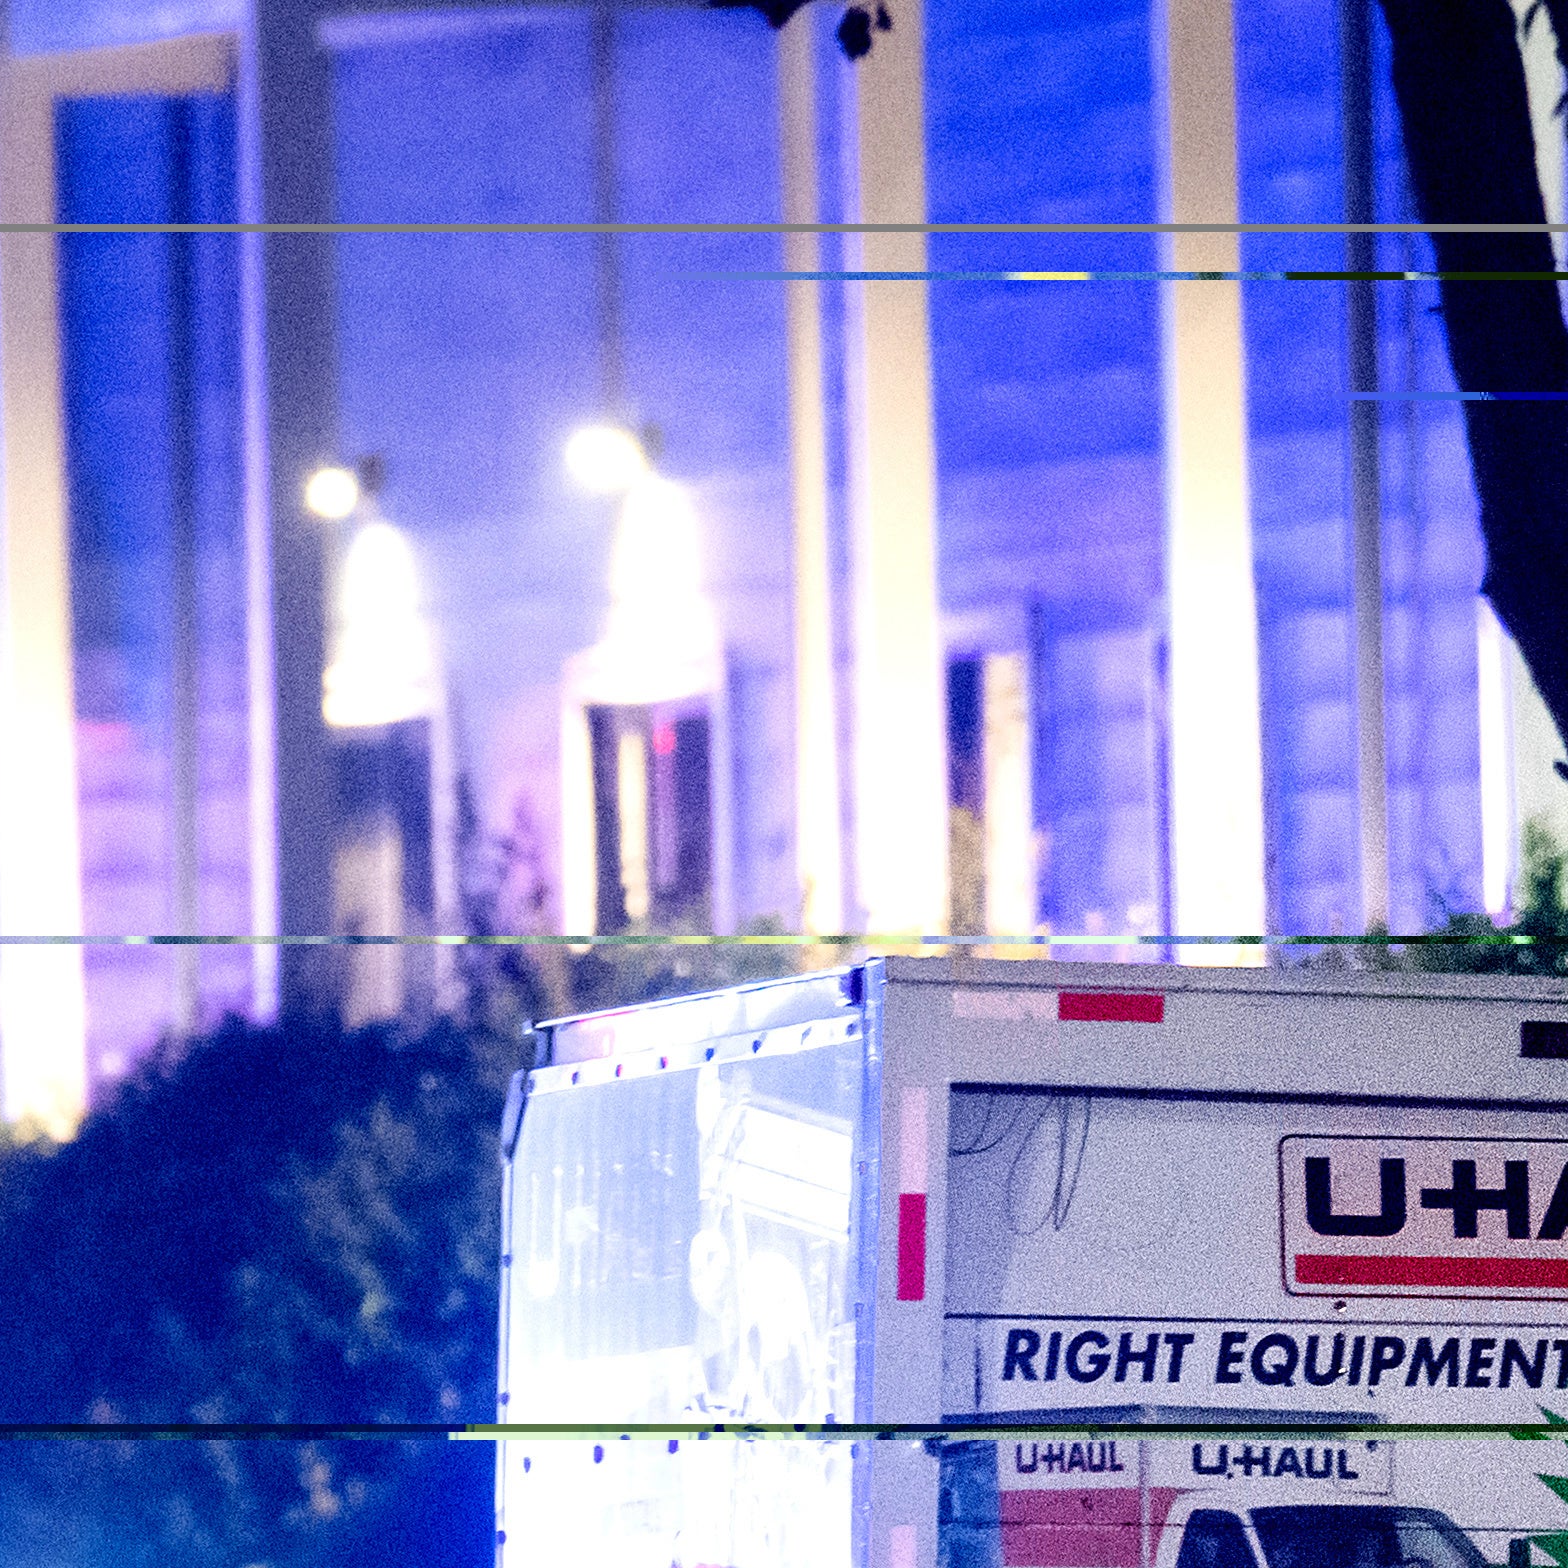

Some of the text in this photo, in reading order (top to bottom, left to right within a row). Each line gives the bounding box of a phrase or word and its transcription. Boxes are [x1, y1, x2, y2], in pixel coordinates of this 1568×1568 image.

[1001, 1329, 1194, 1384] RIGHT
[1016, 1440, 1124, 1474] U-HAUL
[1192, 1443, 1359, 1480] U-HAUL
